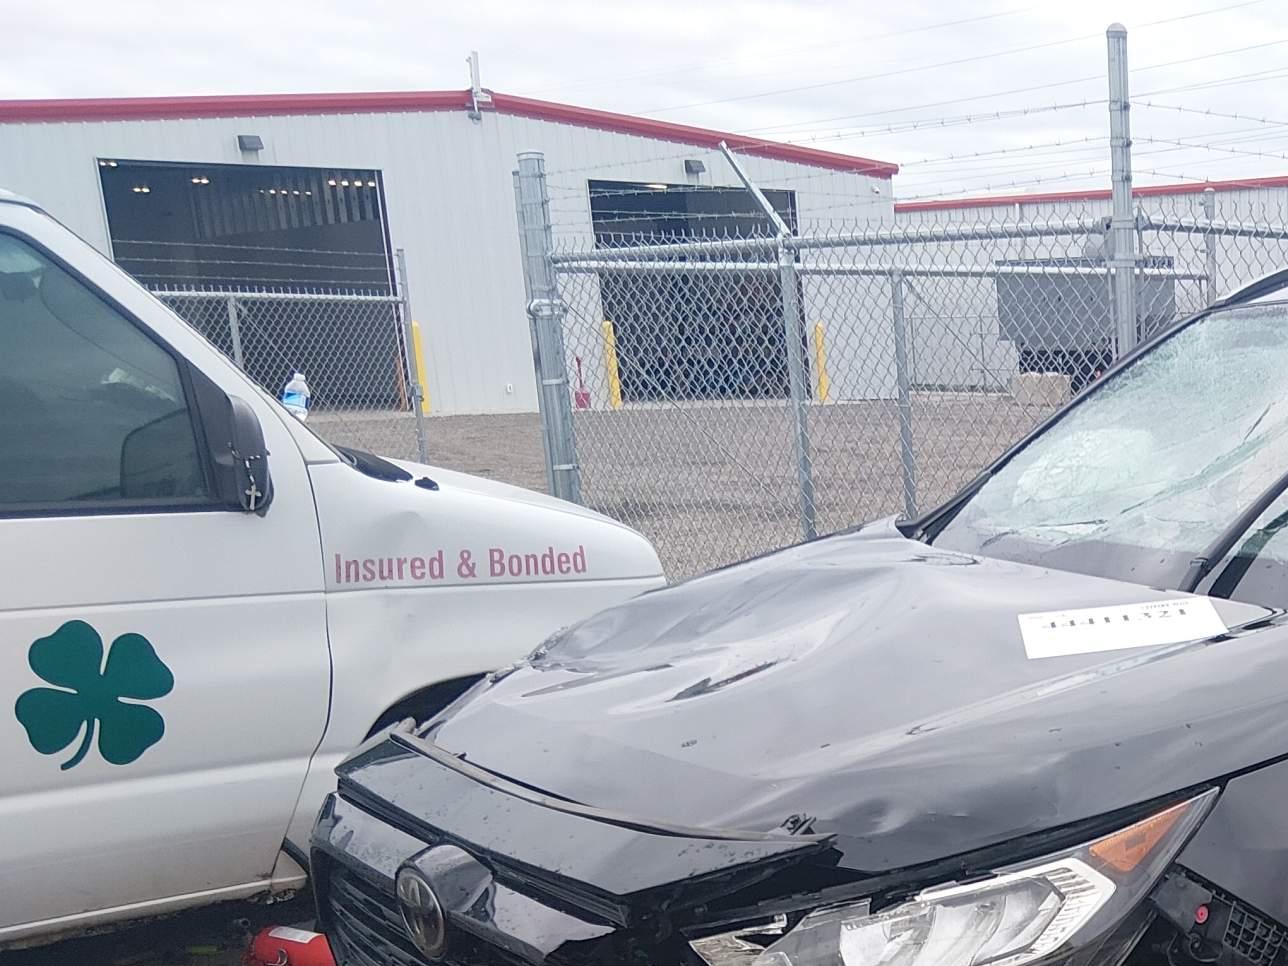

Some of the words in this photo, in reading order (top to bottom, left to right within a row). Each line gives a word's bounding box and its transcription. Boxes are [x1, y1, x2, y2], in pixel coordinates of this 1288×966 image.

[334, 550, 445, 584] Insured
[456, 549, 478, 578] &
[489, 545, 588, 577] Bonded
